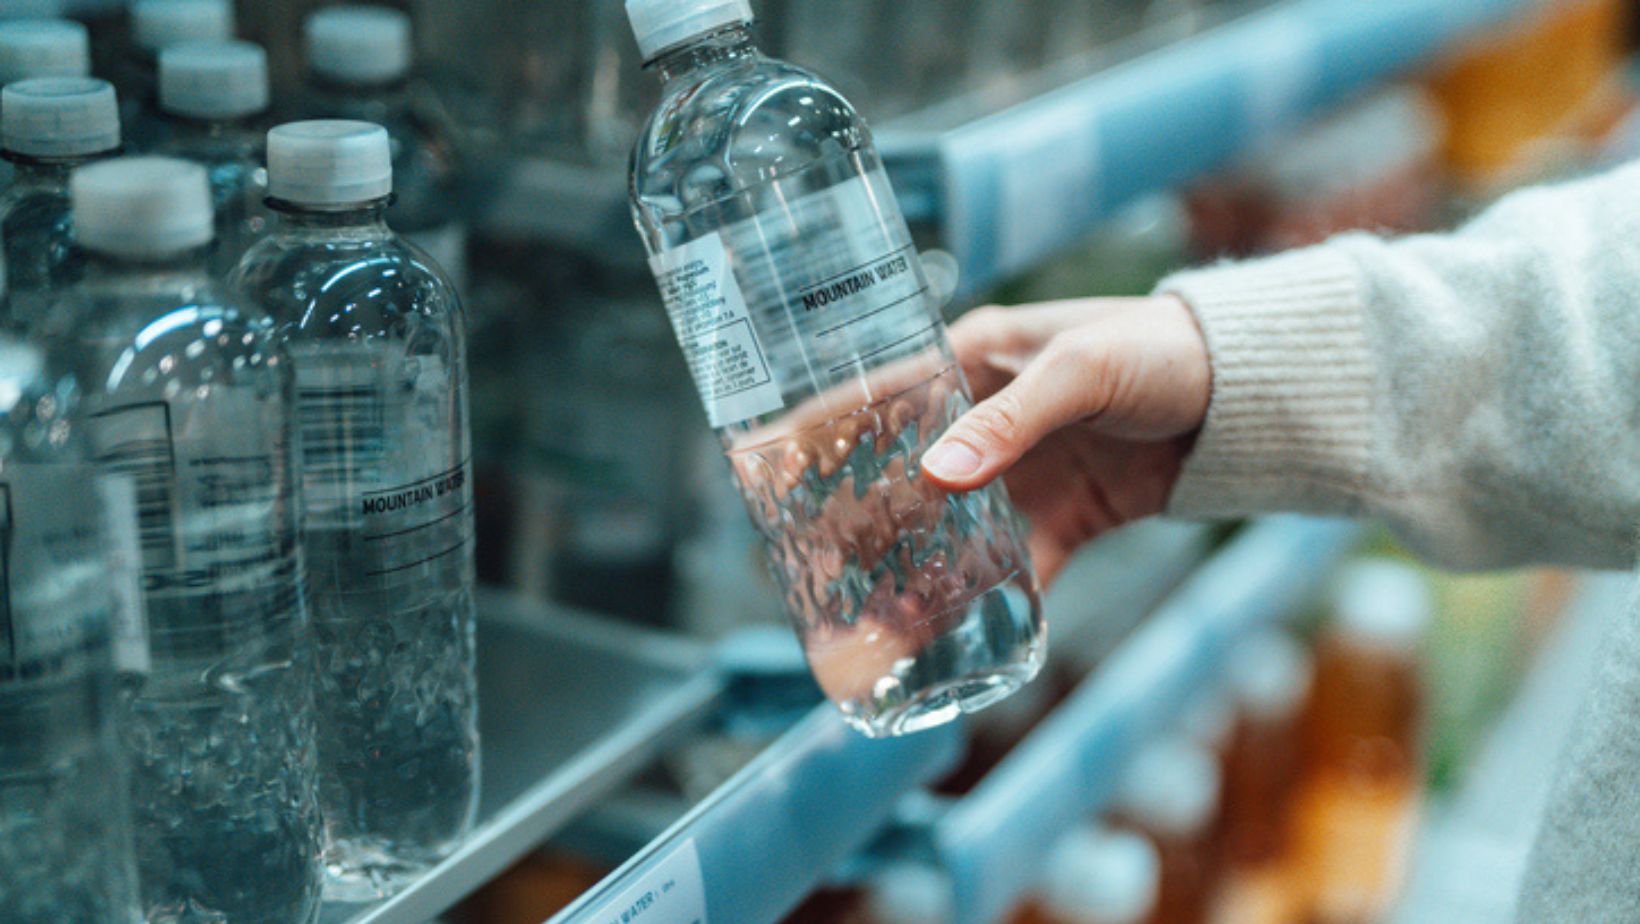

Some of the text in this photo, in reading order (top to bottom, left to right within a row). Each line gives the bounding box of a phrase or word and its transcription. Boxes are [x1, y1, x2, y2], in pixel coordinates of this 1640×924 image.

[803, 255, 908, 312] MOUNTAIN WATER
[362, 484, 434, 515] MOUNTAIN
[621, 891, 653, 923] WATER
